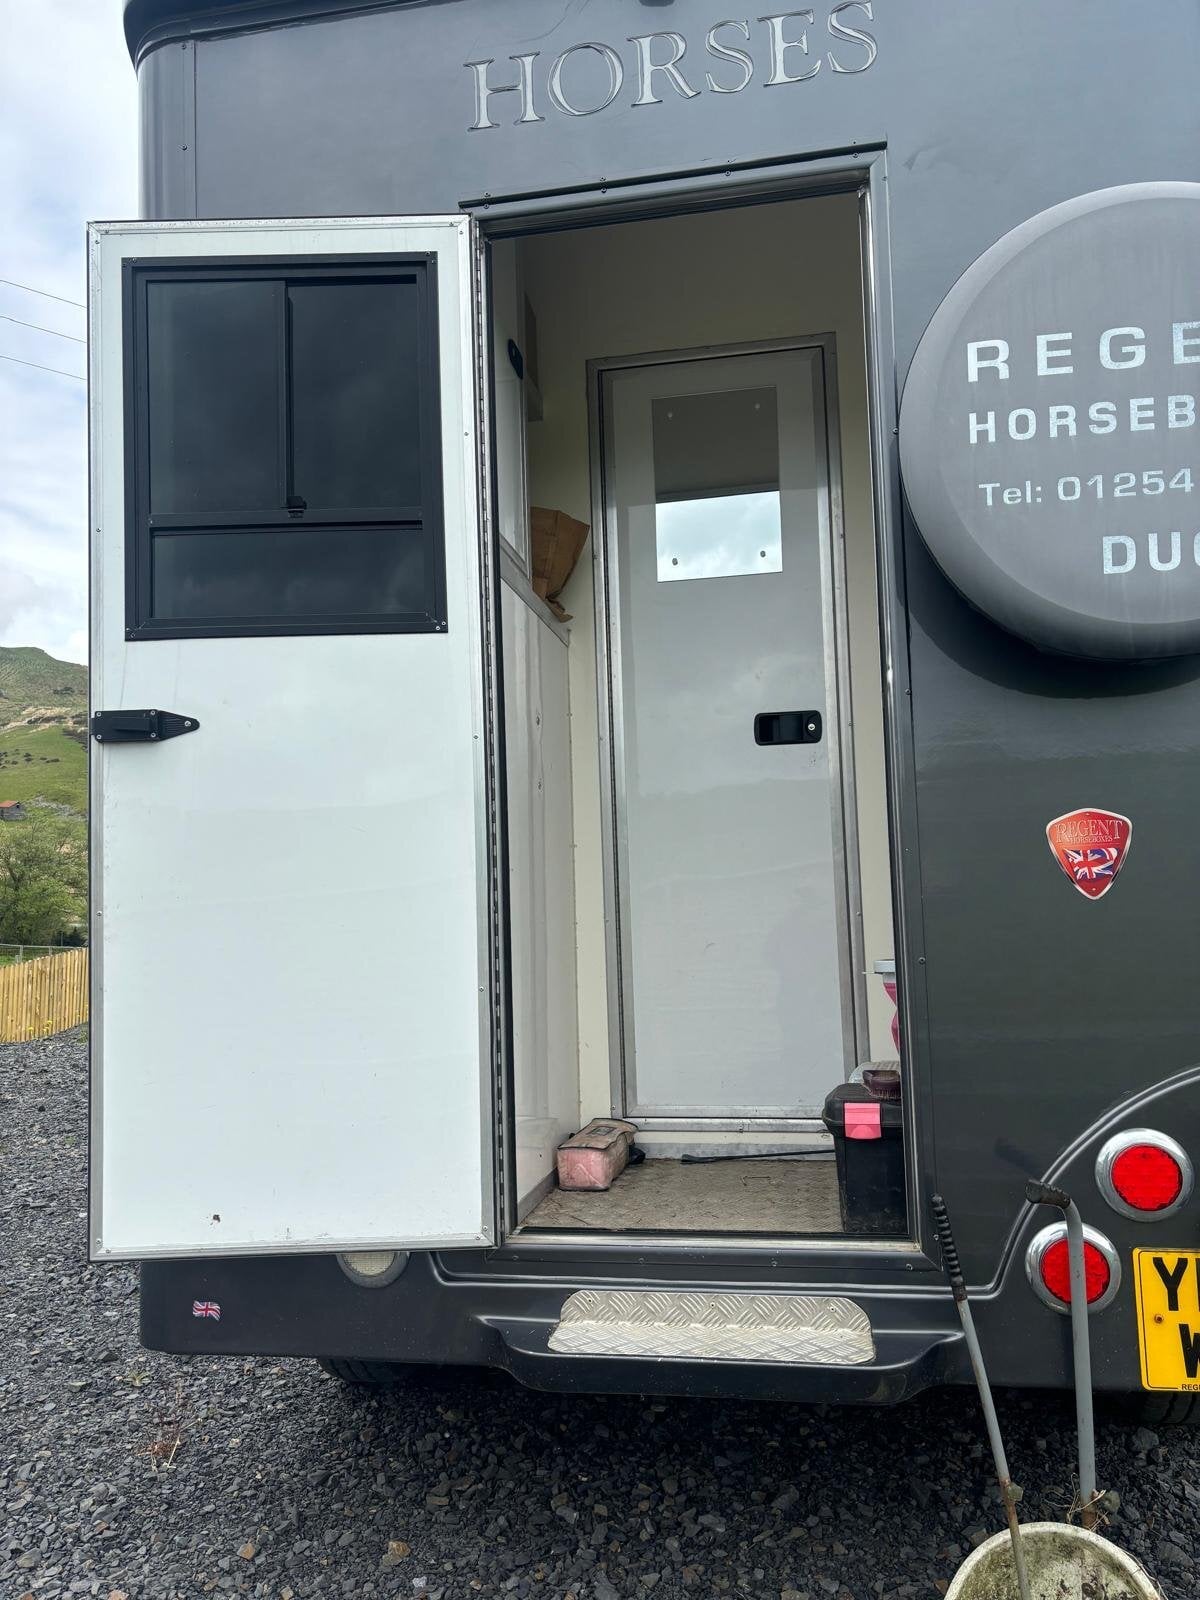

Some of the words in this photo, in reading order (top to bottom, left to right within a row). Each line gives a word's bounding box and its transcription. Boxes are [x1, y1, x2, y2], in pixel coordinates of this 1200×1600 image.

[463, 1, 878, 131] HORSES
[969, 394, 1195, 444] HORSEB
[978, 480, 1042, 506] Tel:
[1057, 468, 1195, 501] 01254
[1102, 531, 1200, 574] DU
[1055, 819, 1123, 843] REGENT
[1152, 1257, 1200, 1312] Y
